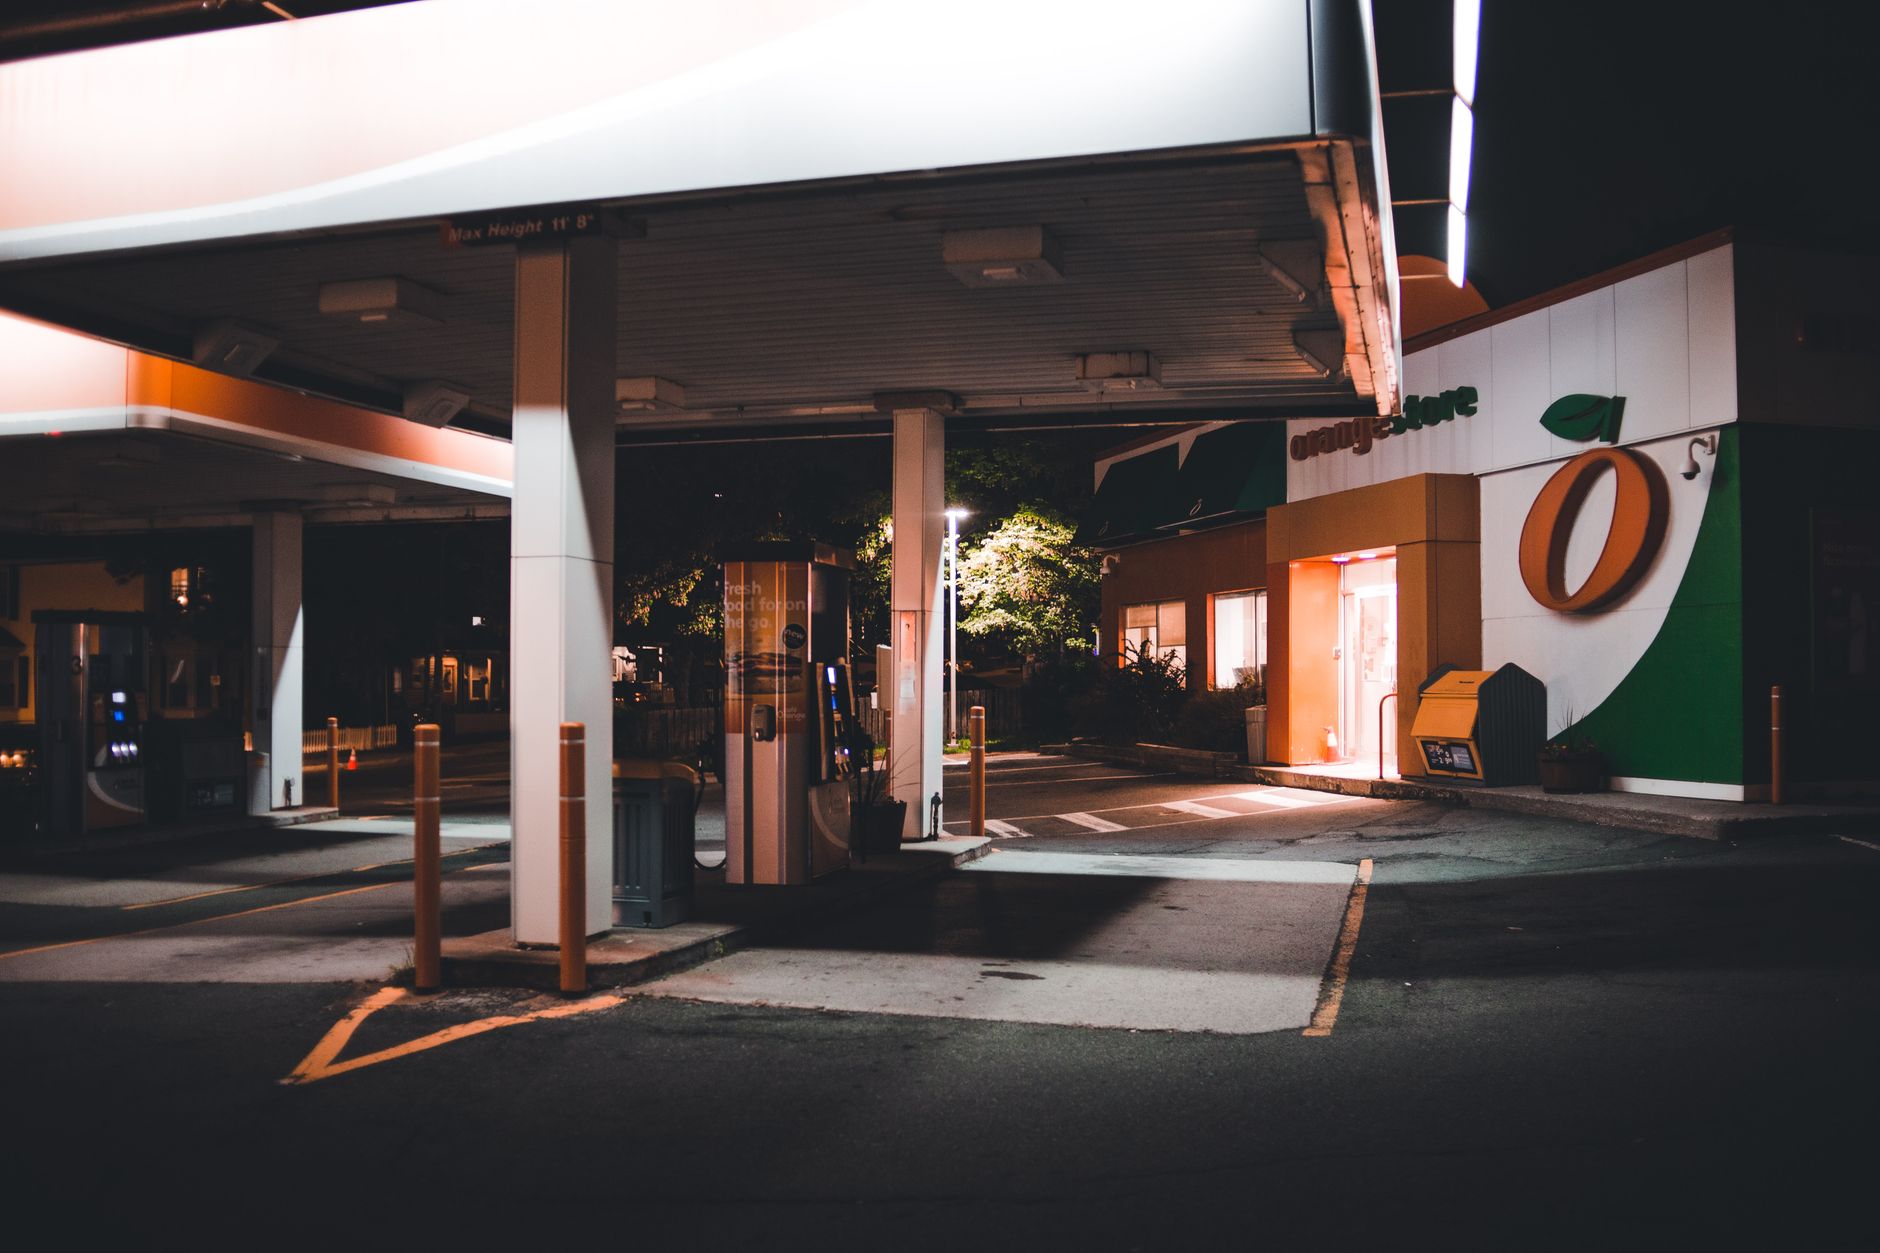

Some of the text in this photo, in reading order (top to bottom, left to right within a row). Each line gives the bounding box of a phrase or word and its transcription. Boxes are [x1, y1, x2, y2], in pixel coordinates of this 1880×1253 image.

[448, 227, 481, 242] Max
[487, 219, 542, 238] Height
[724, 596, 806, 612] ood for on
[724, 614, 745, 628] he
